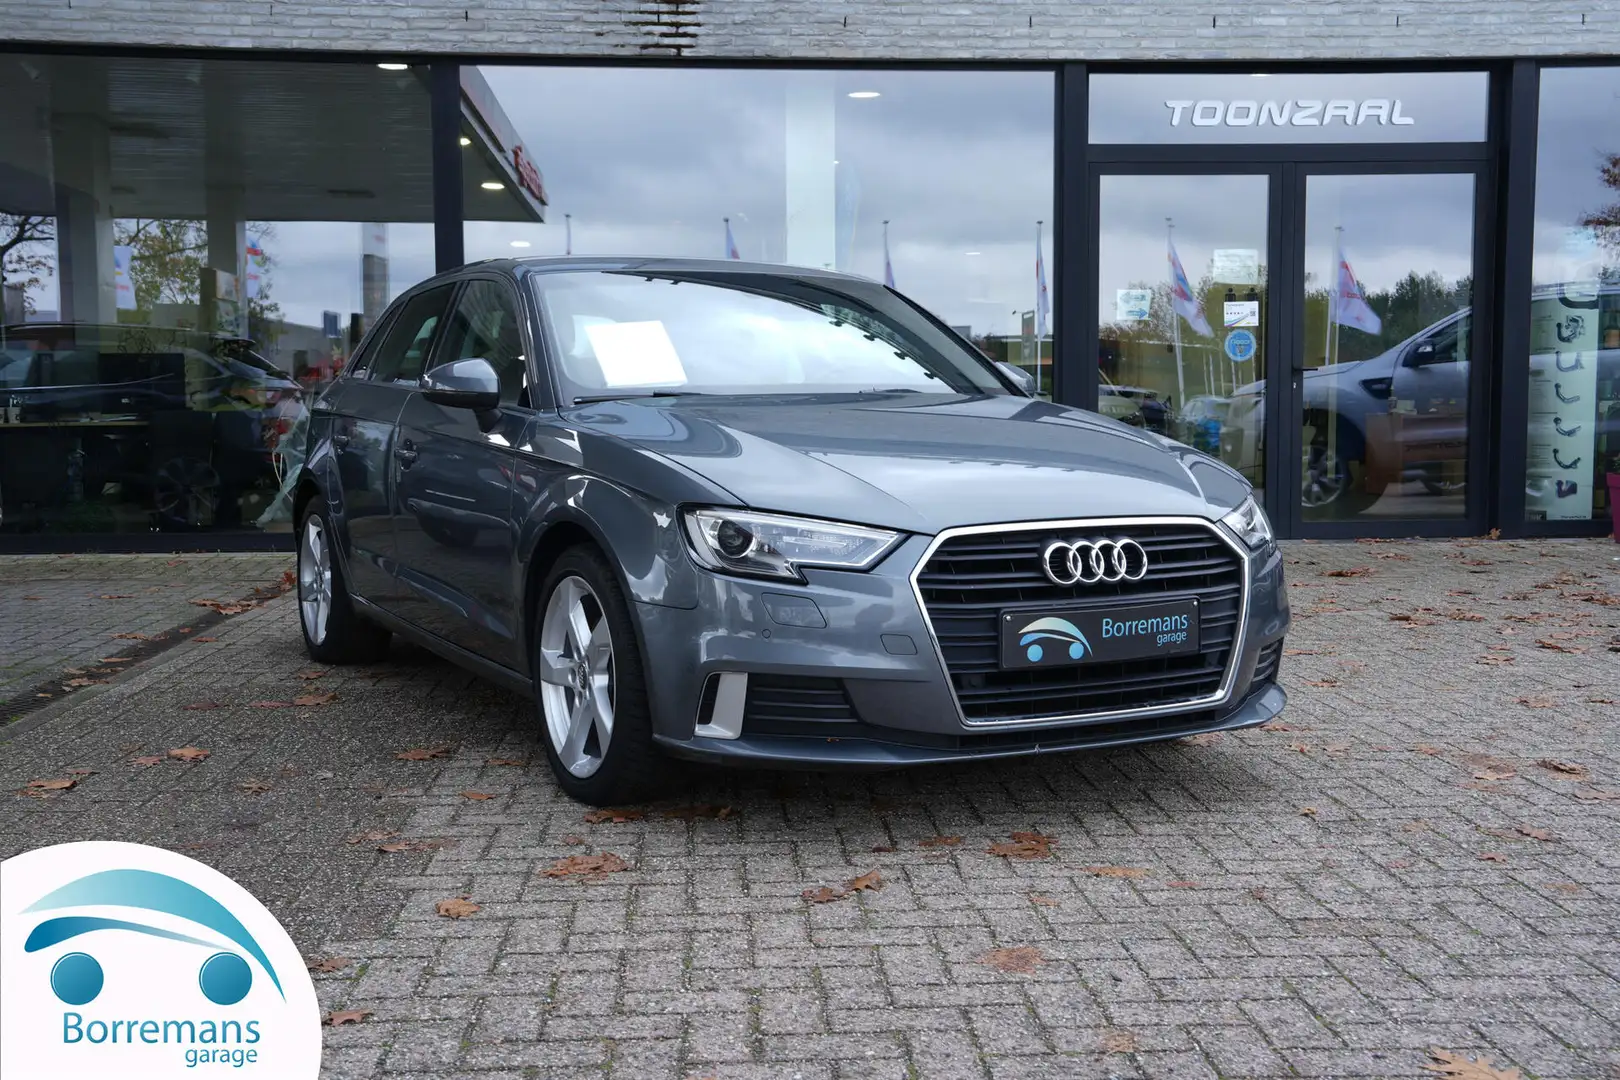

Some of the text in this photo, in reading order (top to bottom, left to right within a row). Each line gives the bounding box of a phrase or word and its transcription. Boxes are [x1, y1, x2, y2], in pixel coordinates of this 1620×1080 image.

[1165, 99, 1415, 127] TOONZAAL
[1102, 614, 1188, 638] Borremans
[1156, 631, 1187, 646] garage
